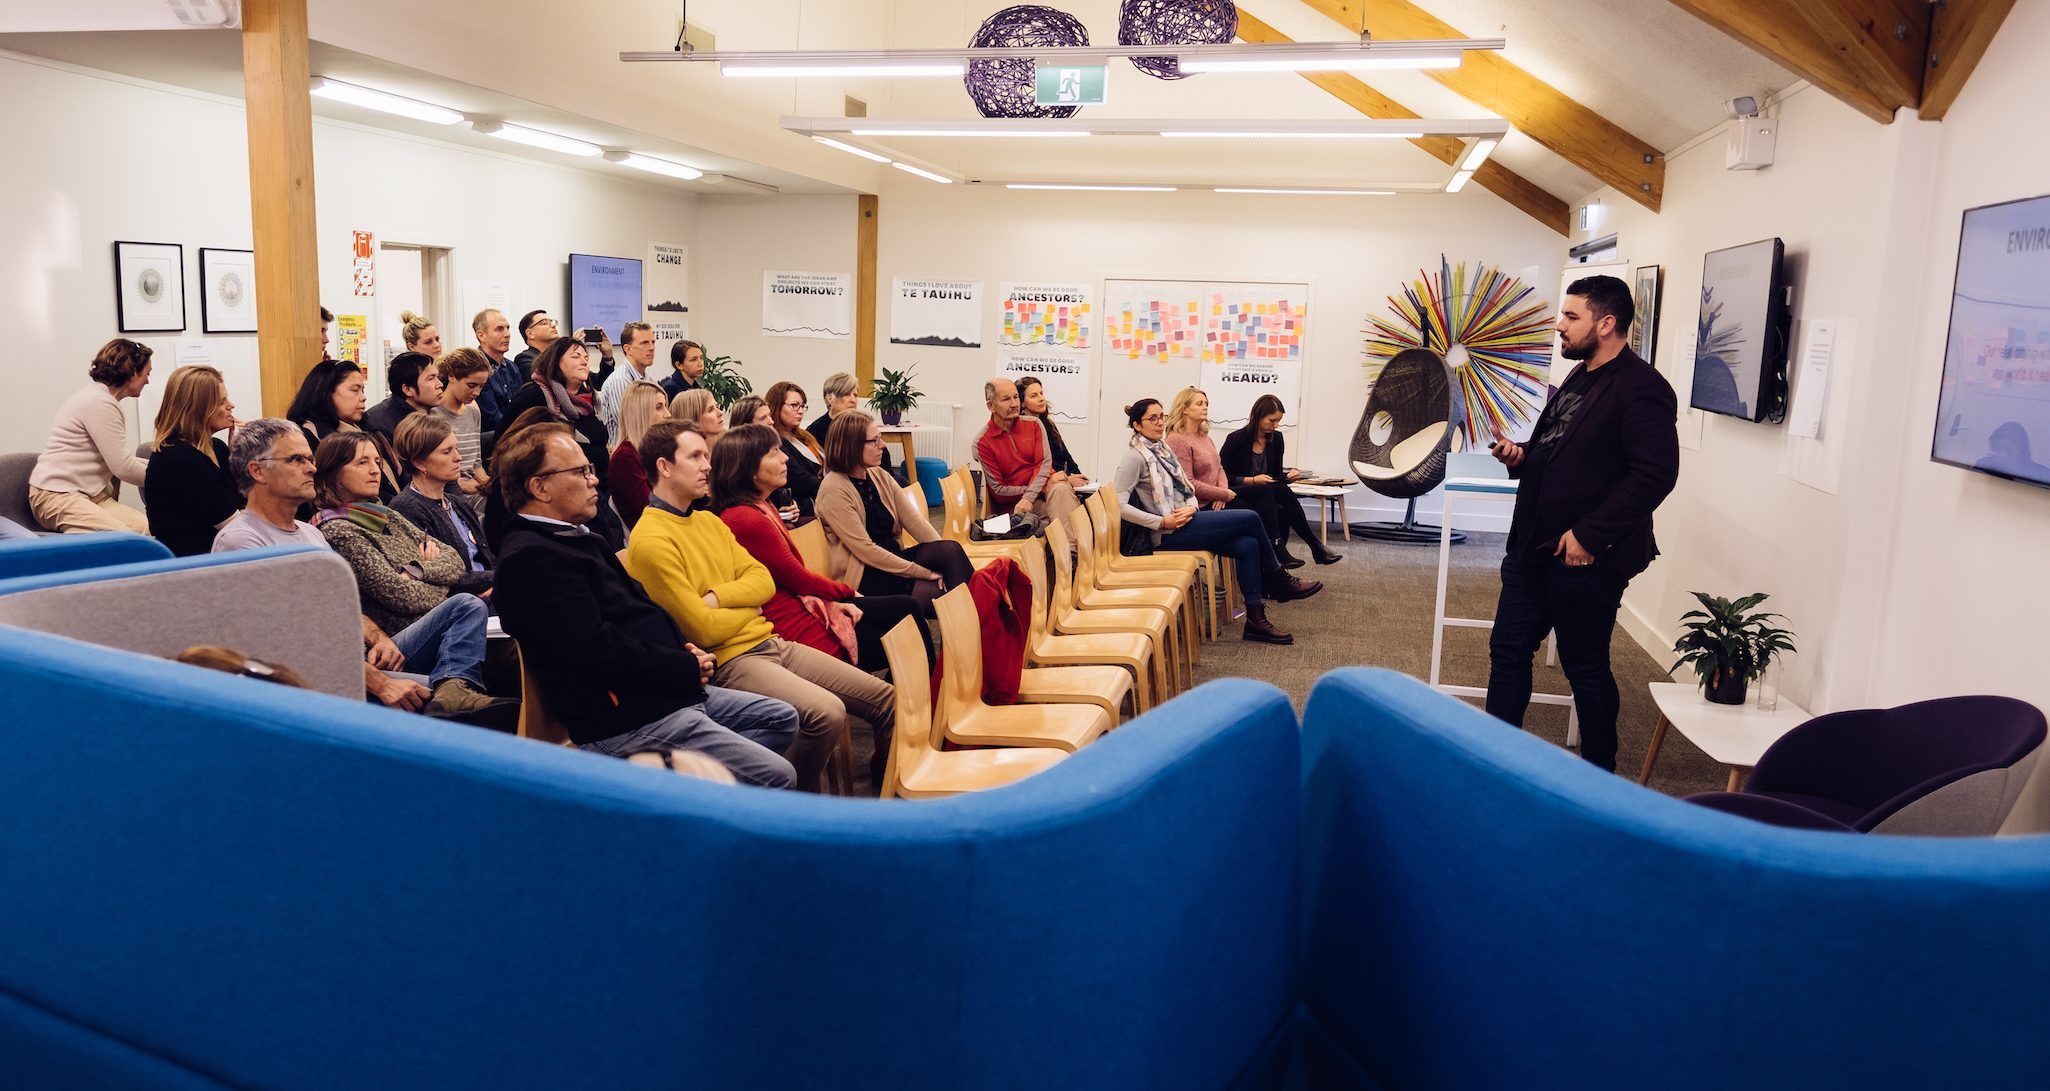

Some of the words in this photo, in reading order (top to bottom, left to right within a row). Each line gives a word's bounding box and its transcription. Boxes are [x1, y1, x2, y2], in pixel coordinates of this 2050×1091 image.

[656, 253, 682, 265] CHANGE
[591, 265, 625, 276] ENVIRONMENT
[771, 284, 844, 296] TOMORROW?
[902, 288, 917, 298] TE
[922, 289, 972, 301] TAUIHU
[1010, 292, 1085, 303] ANCESTORS?
[661, 330, 684, 340] TAUIHU
[1006, 362, 1081, 374] ANCESTORS?
[1221, 372, 1279, 384] HEARD?
